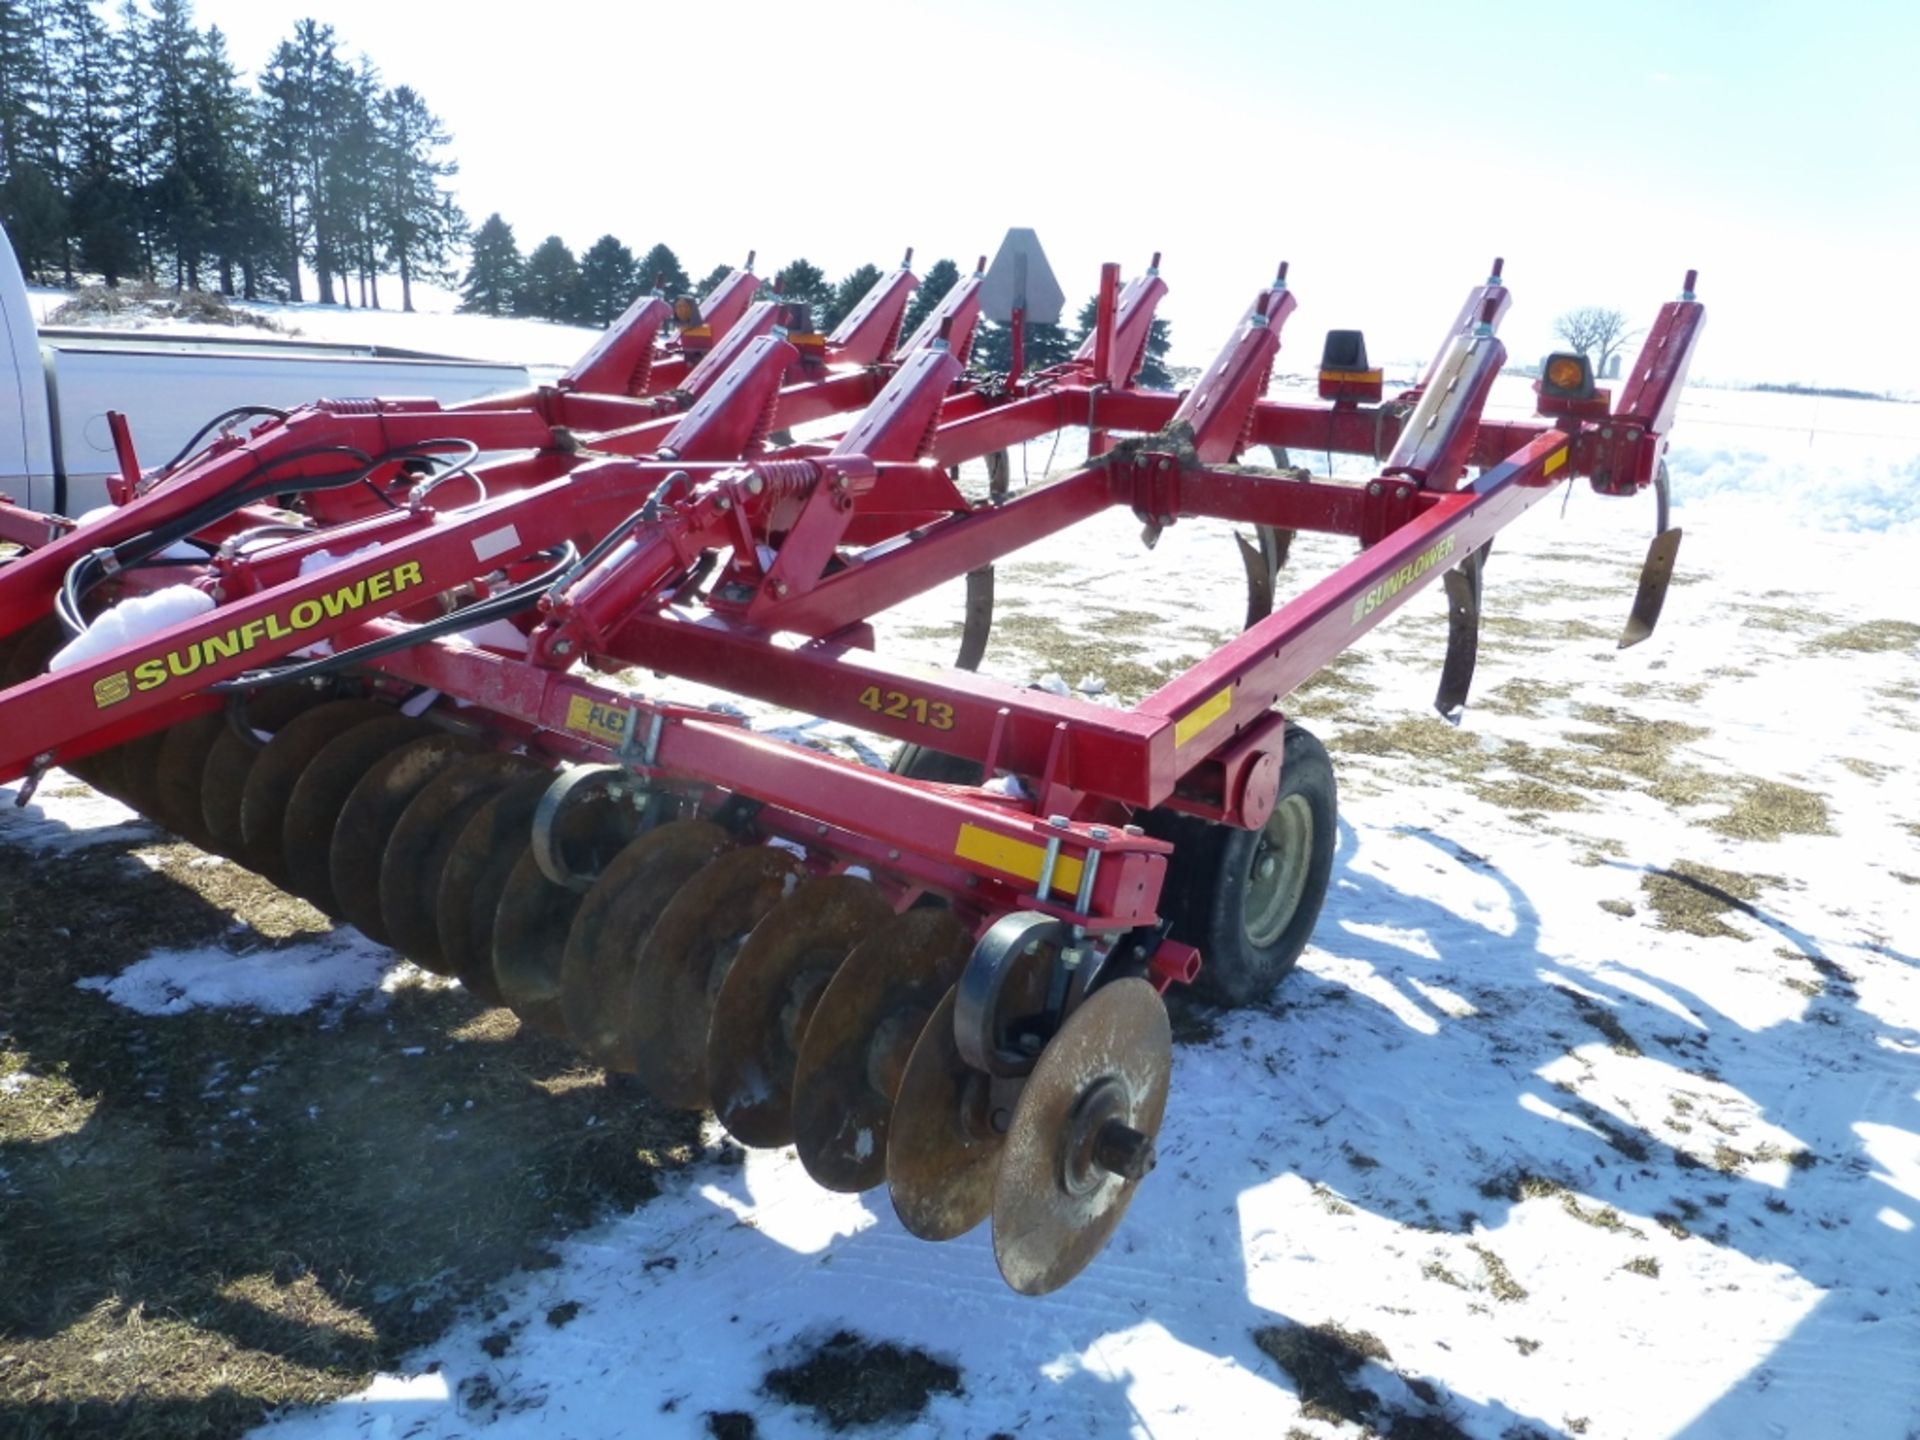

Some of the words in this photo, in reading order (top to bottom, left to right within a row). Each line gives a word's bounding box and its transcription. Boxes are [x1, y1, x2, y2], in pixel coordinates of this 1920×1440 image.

[1364, 533, 1456, 614] SUNFLOWER
[132, 560, 424, 692] SUNFLOWER
[857, 684, 956, 731] 4213
